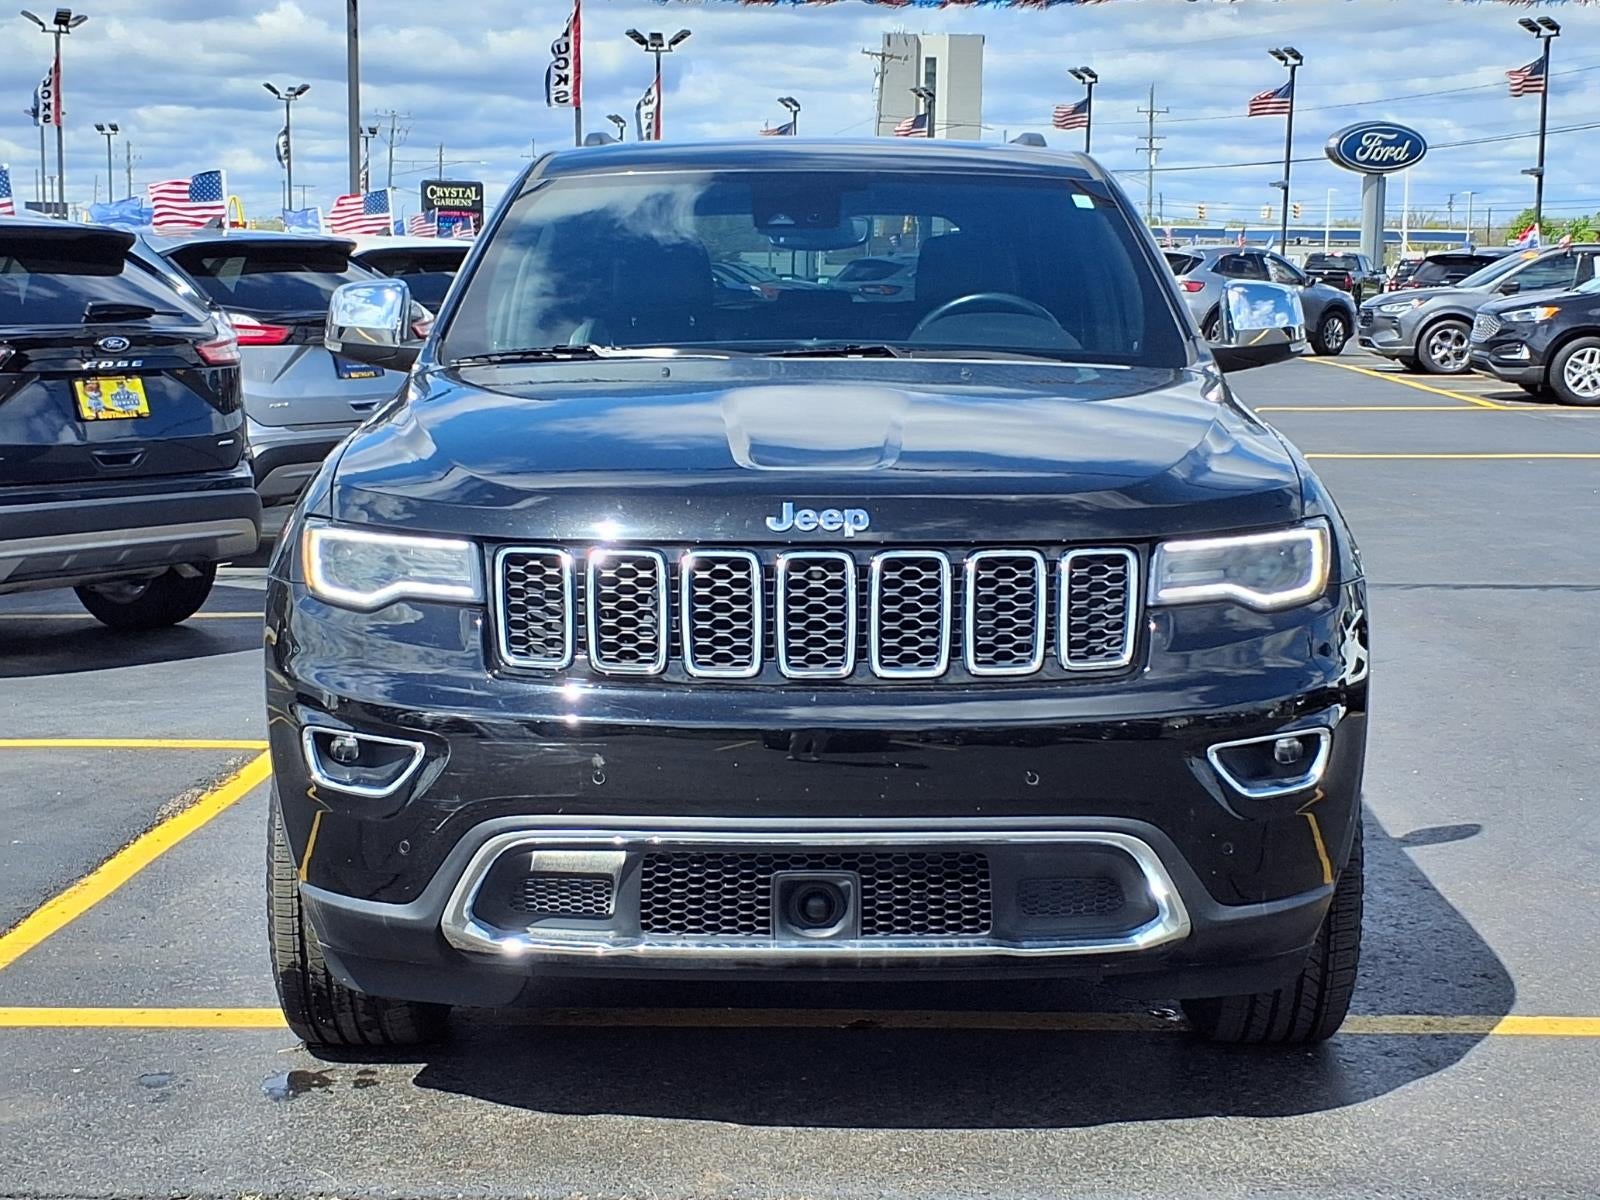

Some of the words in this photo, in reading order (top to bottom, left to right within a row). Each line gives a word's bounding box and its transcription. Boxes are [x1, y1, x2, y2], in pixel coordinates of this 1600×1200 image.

[1356, 132, 1412, 161] Ford
[426, 185, 481, 200] CRYSTAL
[433, 198, 473, 207] GARDENS
[81, 360, 143, 370] EDGE
[765, 502, 870, 538] Jeep
